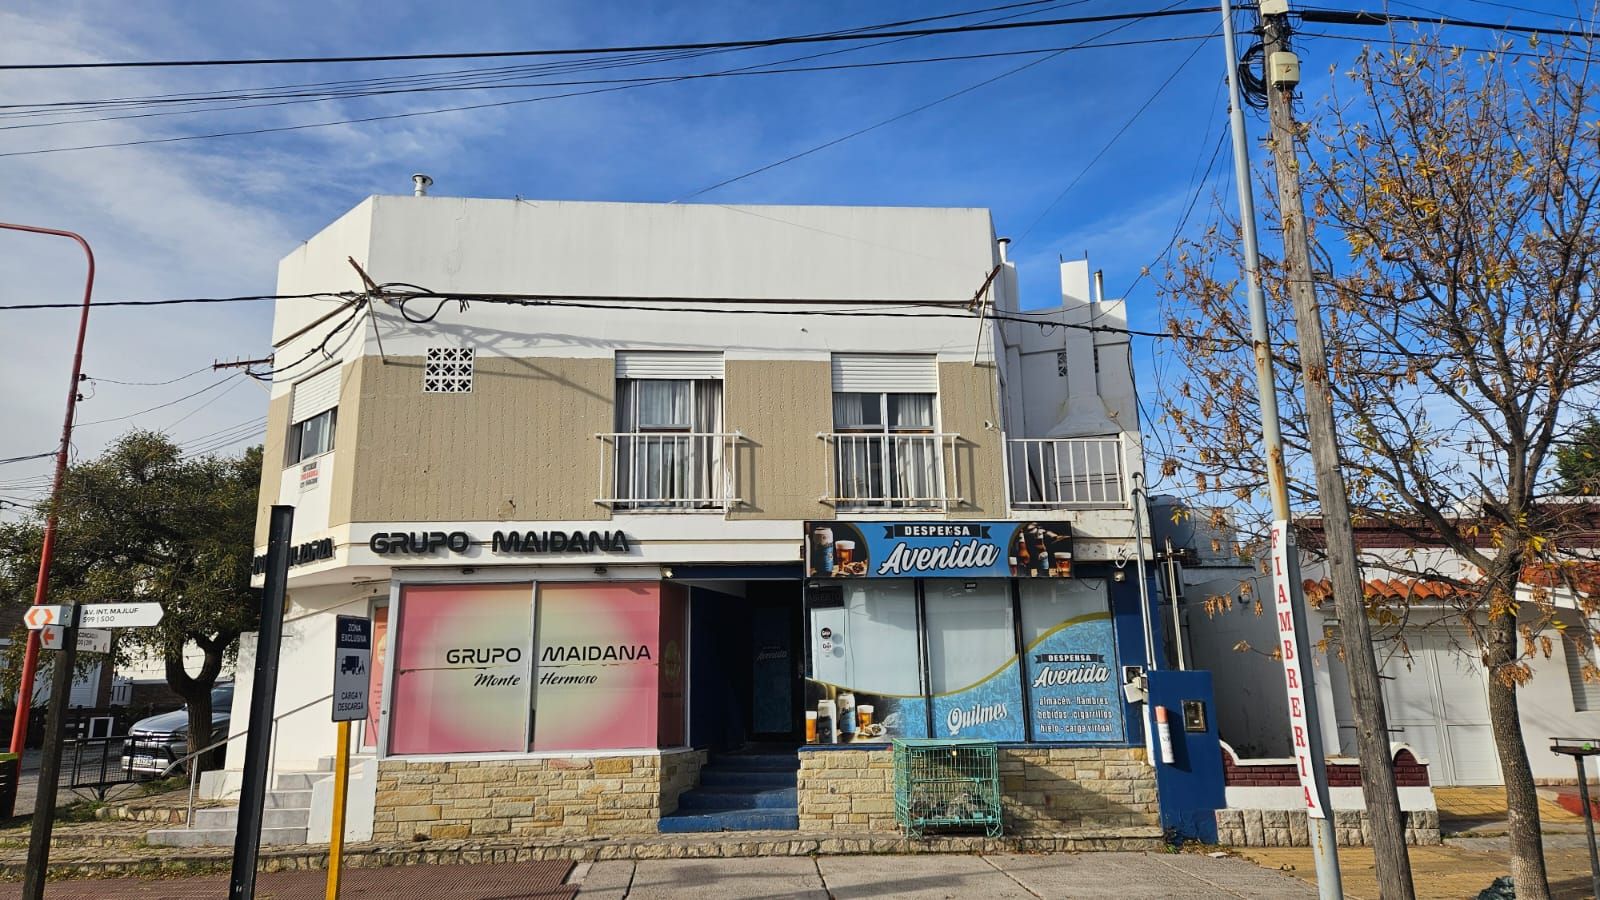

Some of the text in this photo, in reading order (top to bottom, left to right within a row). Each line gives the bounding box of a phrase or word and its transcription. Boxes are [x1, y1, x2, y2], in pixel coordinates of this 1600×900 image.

[904, 525, 971, 536] DESPENSA
[369, 529, 631, 554] GRUPO MAIDANA
[877, 539, 1001, 575] Avenida
[347, 623, 361, 632] ZONA
[341, 633, 367, 643] EXCLUSIVA
[446, 645, 651, 664] GRUPO MAIDANA
[1048, 654, 1092, 662] DESPENSA
[1271, 528, 1316, 809] FIAMBRERIA
[473, 671, 598, 687] Monte Hermoso
[1032, 663, 1111, 688] Avenida
[341, 692, 359, 700] CARGA
[338, 702, 363, 712] DESCARGA
[947, 702, 1009, 737] Quilmes
[1038, 710, 1067, 719] bebidas
[1072, 710, 1113, 720] cigarrillos
[1040, 724, 1059, 733] hielo
[1066, 724, 1087, 734] carga
[1087, 724, 1113, 733] virtual
